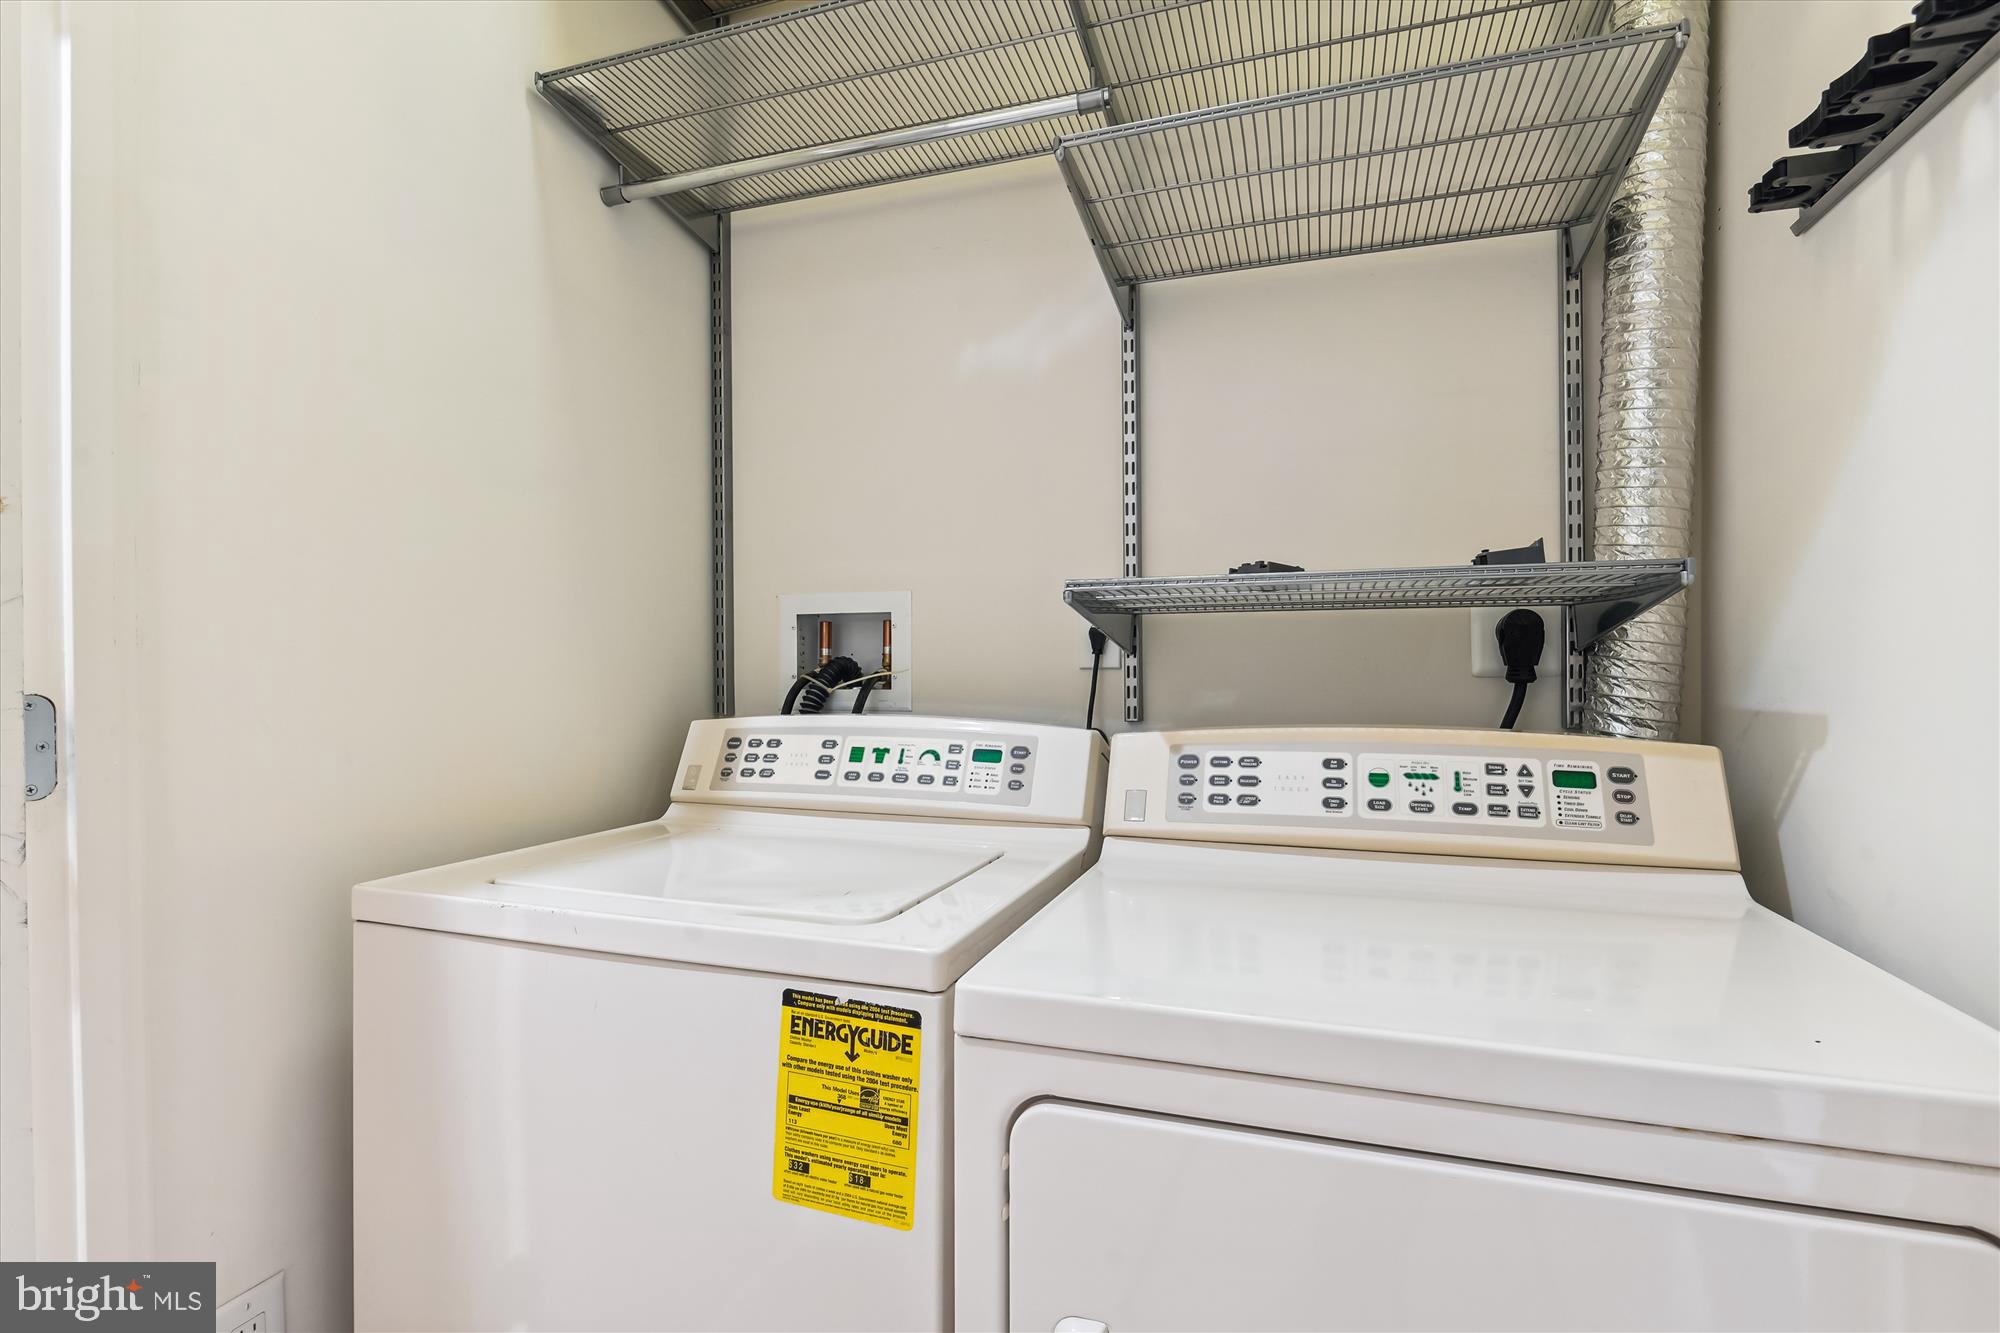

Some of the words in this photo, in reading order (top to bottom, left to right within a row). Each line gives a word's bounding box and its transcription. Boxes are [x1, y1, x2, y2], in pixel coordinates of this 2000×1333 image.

[797, 1000, 816, 1008] Compare
[816, 1003, 826, 1011] only
[884, 1014, 909, 1024] statement.
[800, 994, 814, 1002] model
[848, 1002, 861, 1010] using
[869, 1005, 881, 1013] 2004
[880, 1007, 890, 1015] test
[890, 1009, 914, 1019] procedure.
[790, 1014, 914, 1056] ENERGYGUIDE
[786, 1054, 808, 1065] Compare
[808, 1058, 817, 1066] the
[817, 1060, 834, 1070] energy
[835, 1063, 845, 1071] use
[851, 1066, 862, 1074] this
[862, 1068, 882, 1078] clothes
[882, 1072, 902, 1081] washer
[901, 1076, 913, 1085] only
[793, 1063, 807, 1071] other
[807, 1066, 825, 1074] models
[825, 1069, 841, 1078] tested
[841, 1072, 856, 1082] using
[865, 1077, 879, 1086] 2004
[879, 1080, 890, 1088] test
[890, 1082, 919, 1093] procedure.
[821, 1083, 832, 1091] This
[794, 1097, 810, 1105] Energy
[788, 1109, 803, 1118] Energy
[799, 1105, 811, 1113] Least
[884, 1123, 896, 1131] Uses
[896, 1125, 908, 1133] Most
[891, 1131, 908, 1140] Energy
[784, 1145, 801, 1155] Clothes
[801, 1150, 819, 1158] washers
[819, 1154, 832, 1162] using
[843, 1159, 859, 1168] energy
[870, 1164, 882, 1172] more
[888, 1168, 908, 1177] operate.
[811, 1158, 833, 1167] estimated
[833, 1162, 847, 1171] yearly
[847, 1166, 869, 1176] operating
[849, 1173, 865, 1184] $18
